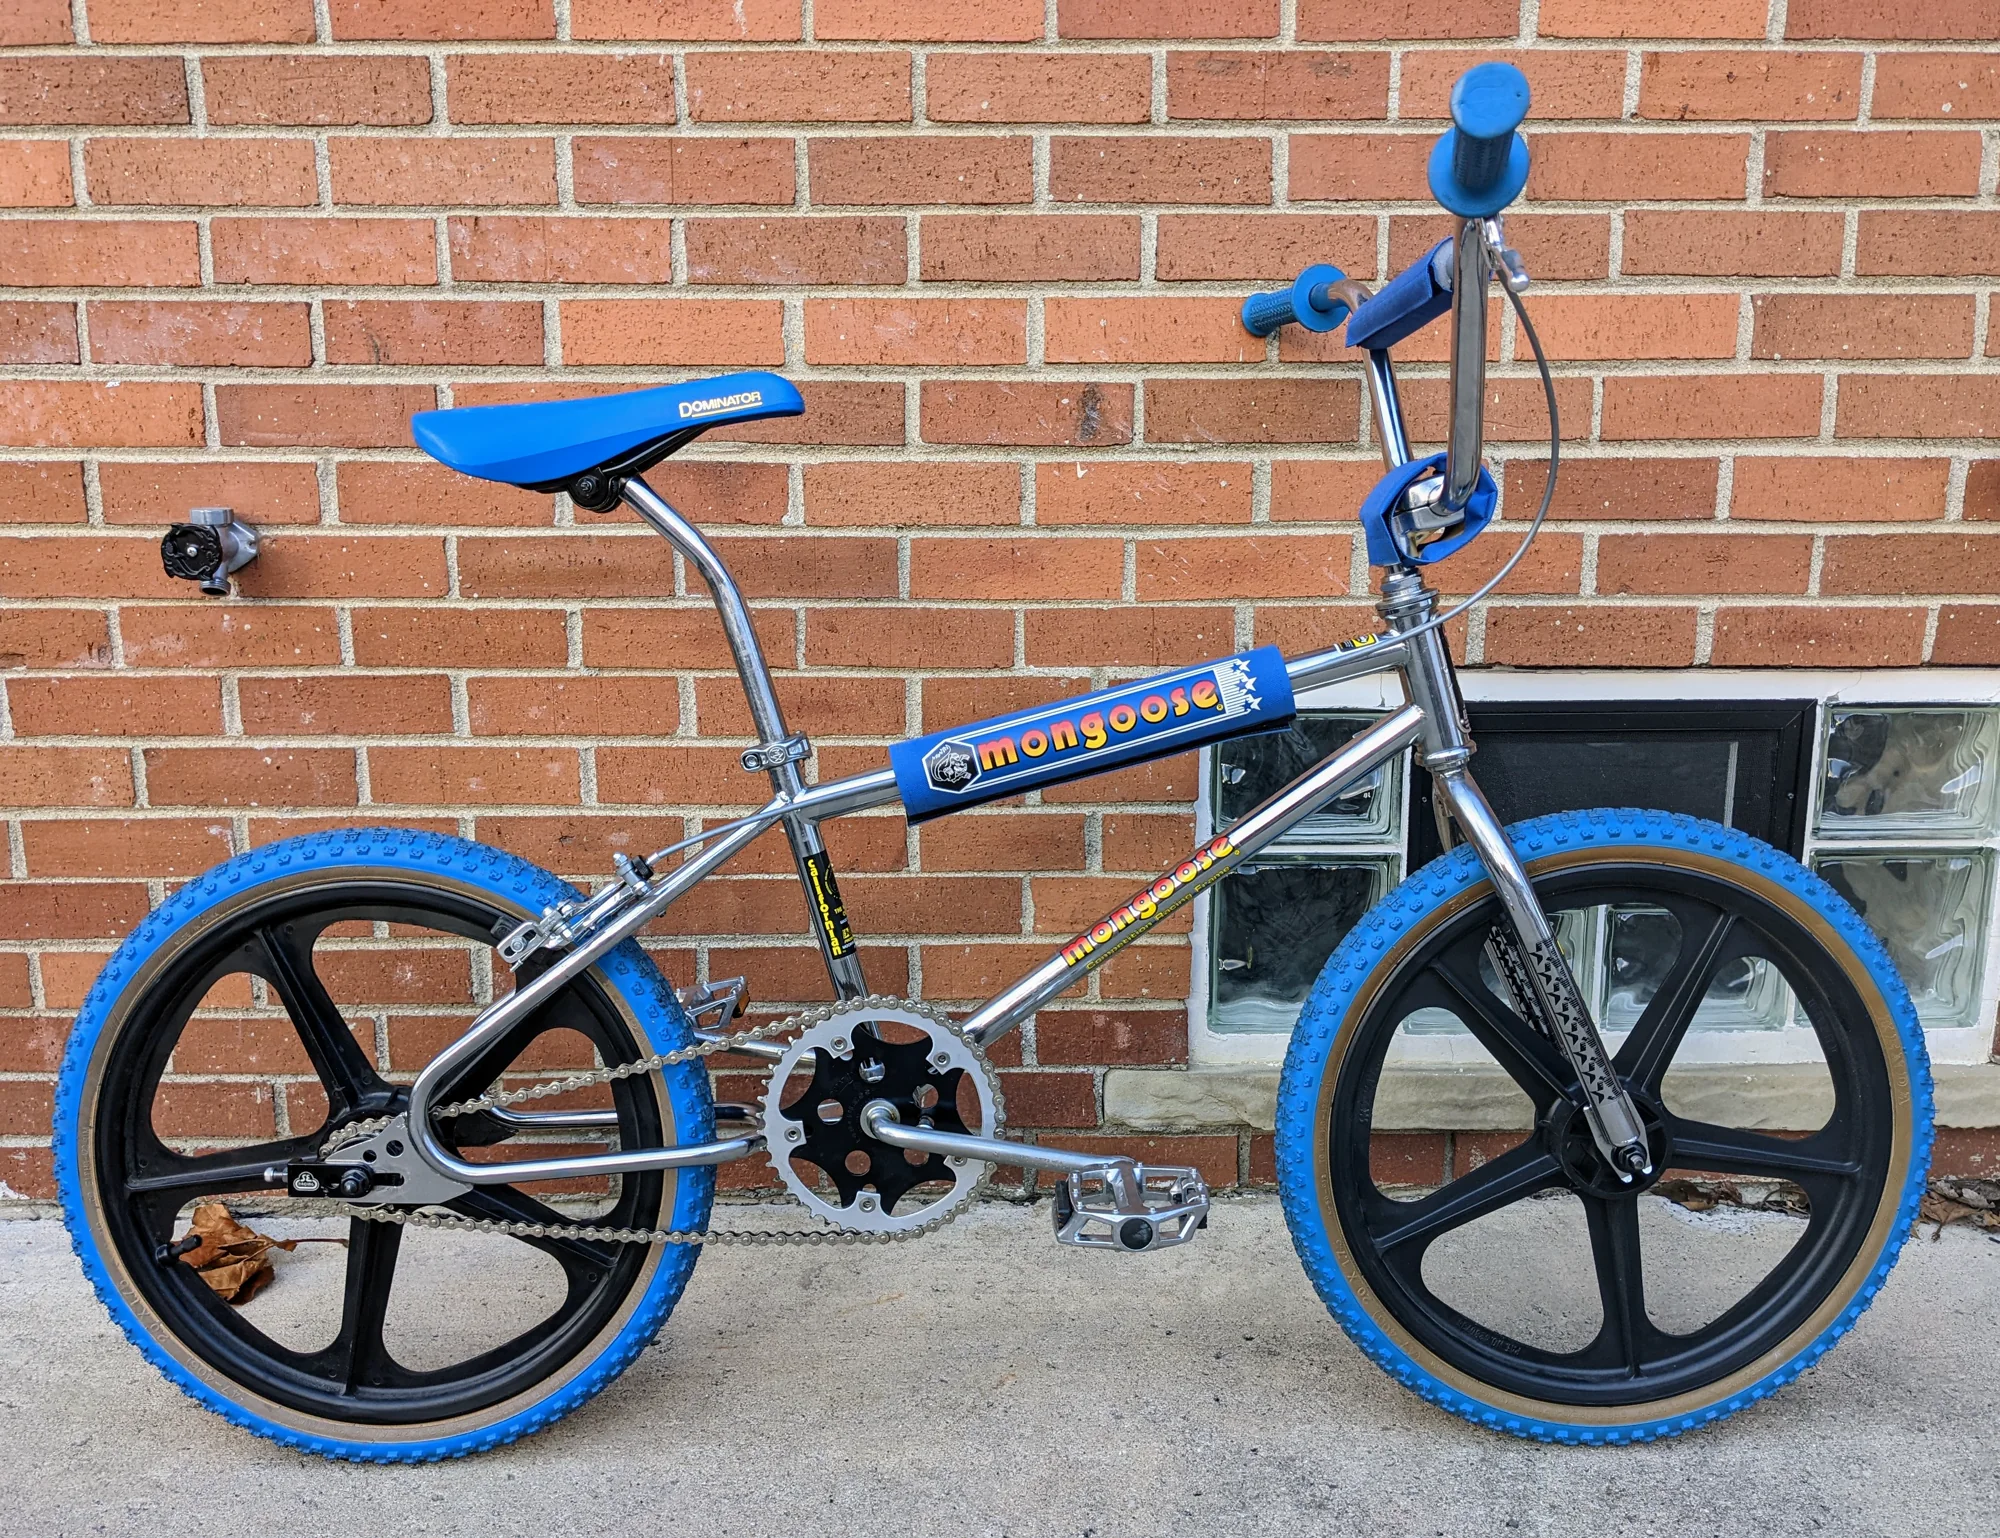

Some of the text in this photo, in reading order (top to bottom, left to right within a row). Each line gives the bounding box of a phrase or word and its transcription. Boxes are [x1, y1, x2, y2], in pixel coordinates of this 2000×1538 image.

[678, 391, 762, 418] DOMINATOR
[976, 679, 1220, 771] mongoose
[1060, 836, 1235, 967] mongoose
[1085, 864, 1231, 970] Competition Racing Frame
